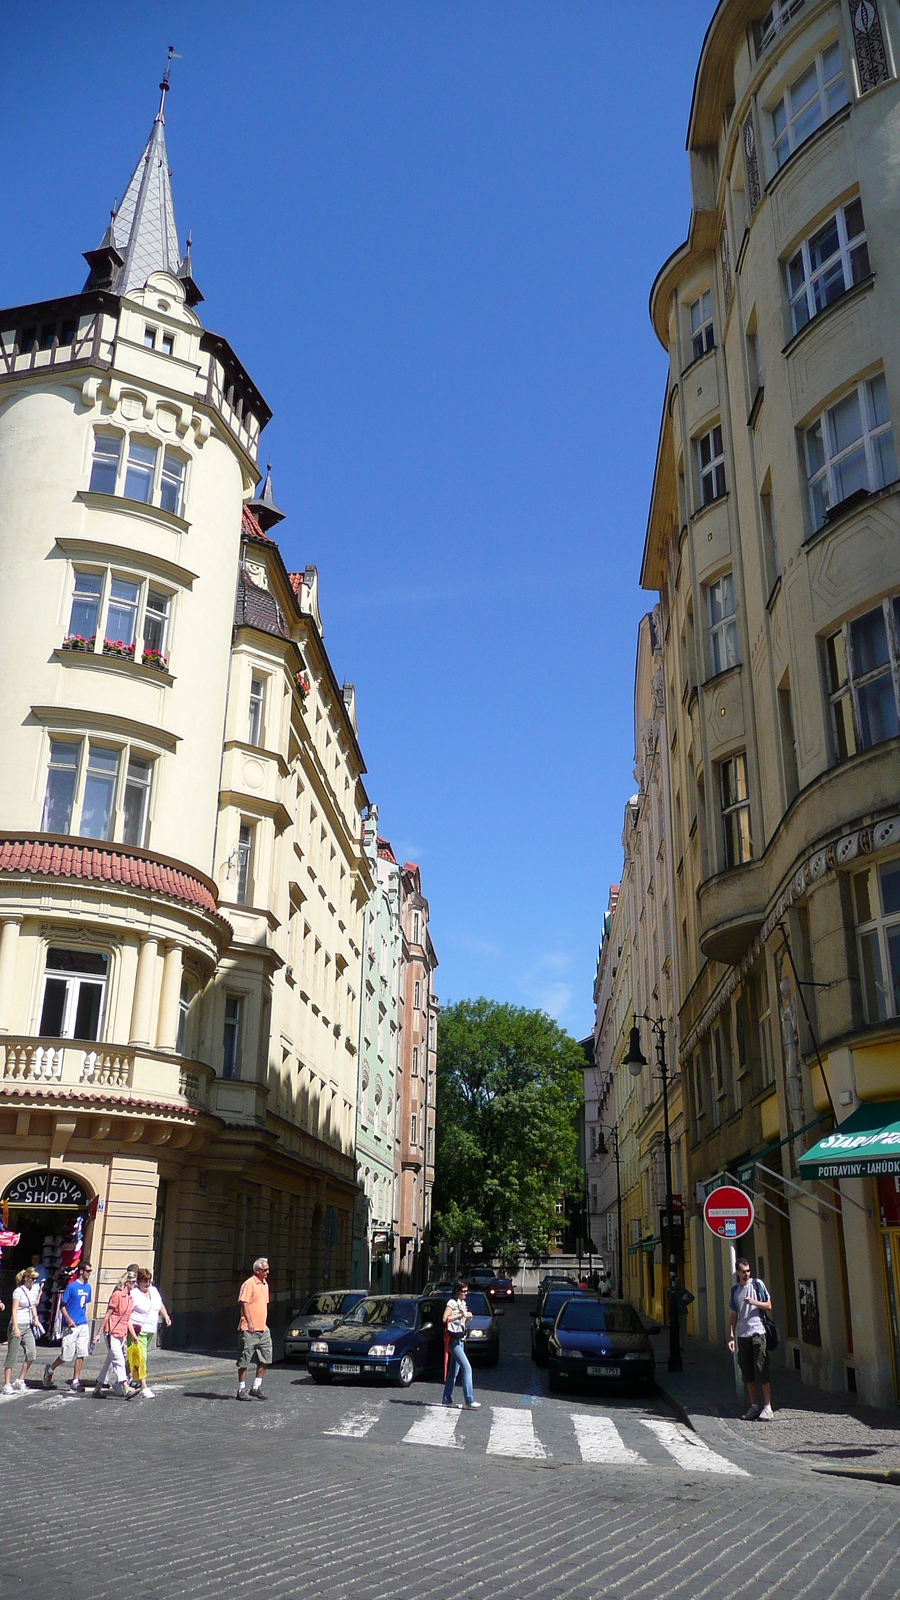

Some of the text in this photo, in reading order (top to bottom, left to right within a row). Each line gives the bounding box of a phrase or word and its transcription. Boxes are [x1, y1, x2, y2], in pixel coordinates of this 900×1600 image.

[820, 1132, 900, 1148] STAROPR
[818, 1164, 862, 1177] POTRAVINY
[9, 1176, 82, 1201] SOUVENIR
[25, 1191, 68, 1203] SHOP
